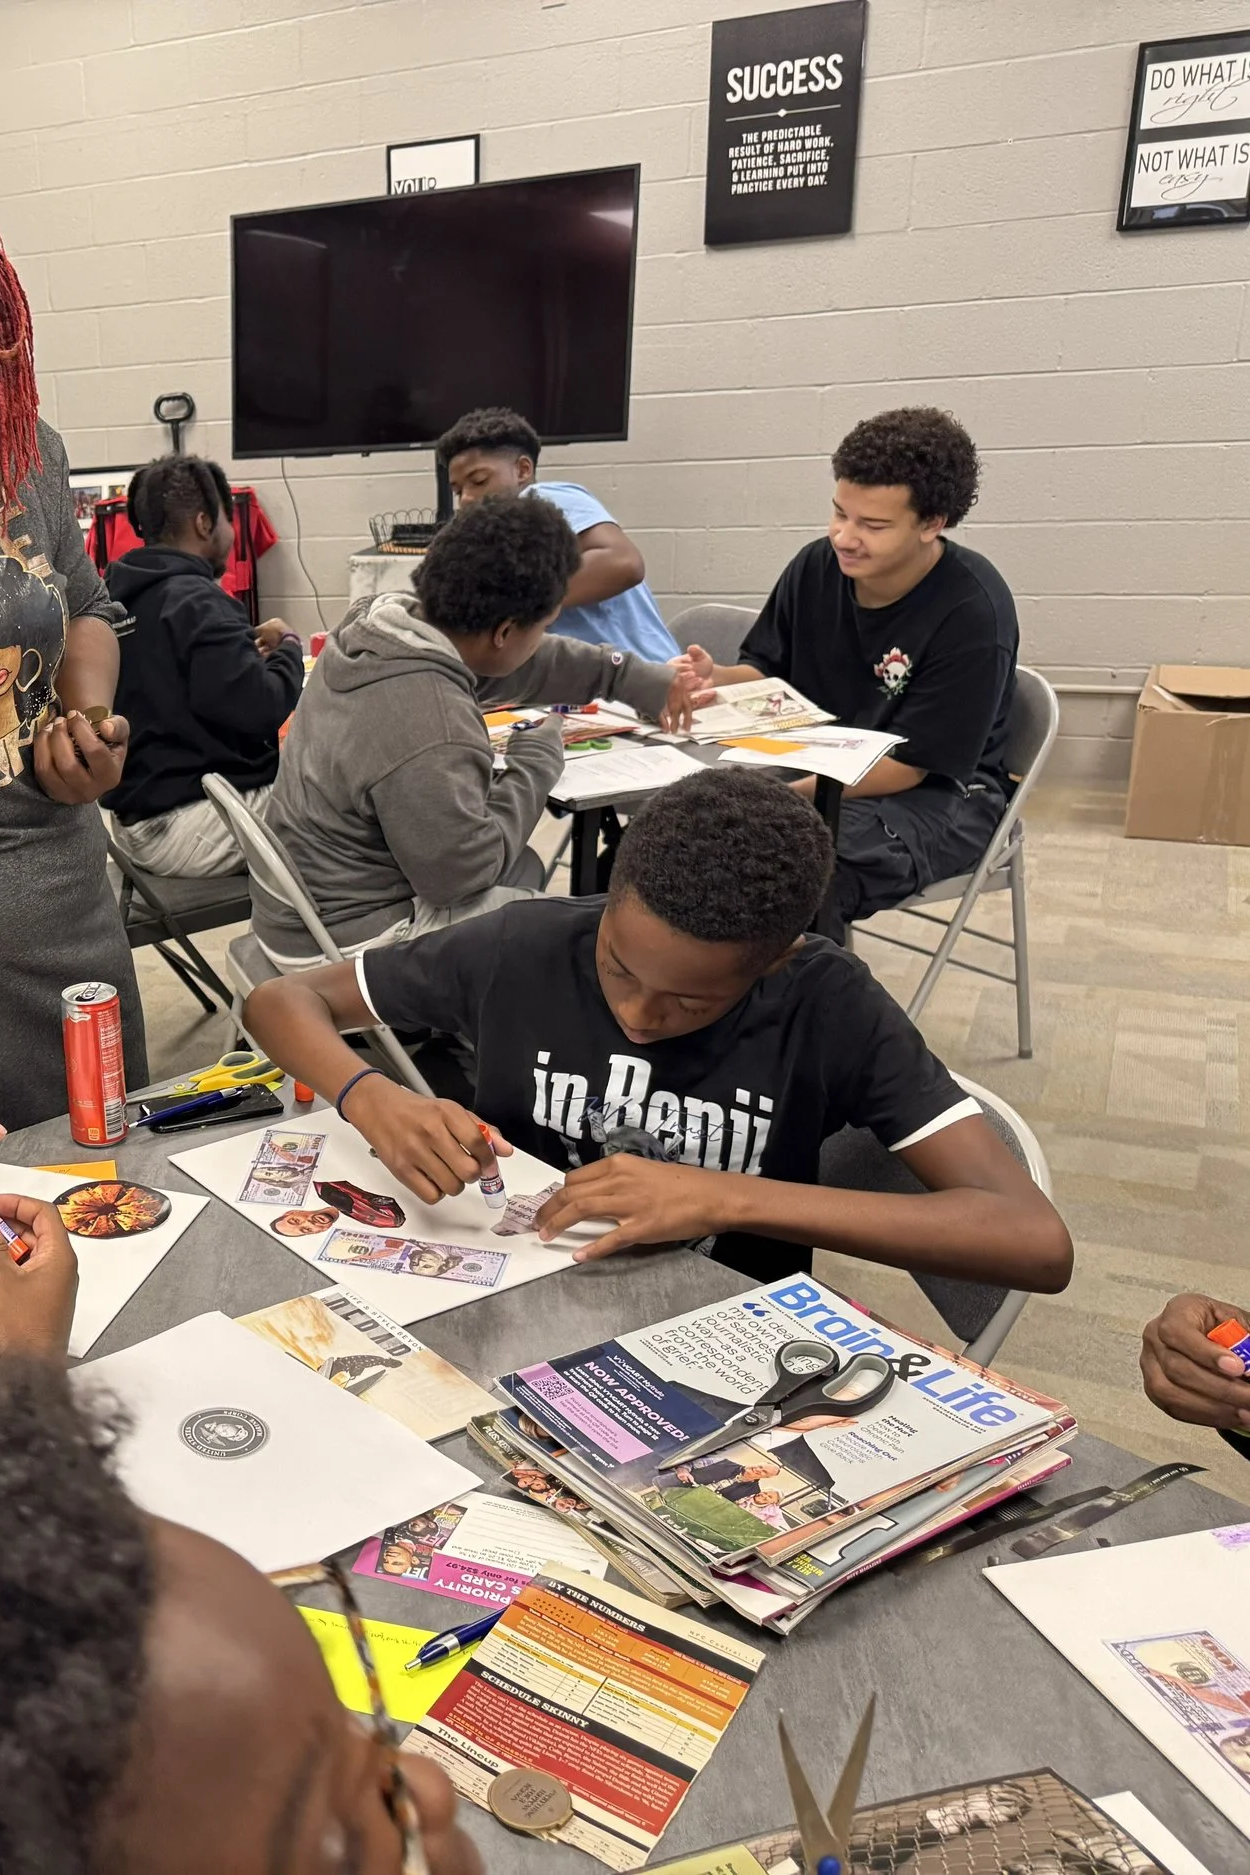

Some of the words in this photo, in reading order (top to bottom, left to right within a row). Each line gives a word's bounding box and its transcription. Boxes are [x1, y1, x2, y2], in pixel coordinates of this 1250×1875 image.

[726, 53, 843, 103] SUCCESS
[1150, 67, 1175, 91] DO
[1182, 60, 1237, 87] WHAT
[742, 132, 759, 144] THE
[761, 124, 822, 142] PREDICTABLE
[729, 144, 761, 158] RESULT
[763, 142, 775, 154] OF
[777, 139, 802, 152] HARD
[1138, 150, 1174, 174] NOT
[1178, 145, 1229, 170] WHAT
[1233, 142, 1250, 165] IS
[732, 170, 739, 182] &
[740, 166, 785, 181] LEARNING
[787, 164, 805, 176] PUT
[807, 161, 829, 174] INTO
[731, 181, 774, 195] PRACTICE
[776, 177, 805, 191] EVERY
[1159, 172, 1223, 201] easy
[534, 1051, 588, 1138] in
[345, 1292, 361, 1304] LIFE
[371, 1311, 396, 1330] STYLE
[716, 1311, 733, 1322] of
[727, 1306, 750, 1322] my
[747, 1320, 777, 1341] own
[650, 1334, 670, 1347] of
[699, 1314, 769, 1364] journalistic
[664, 1329, 696, 1352] from
[693, 1351, 716, 1369] the
[714, 1368, 755, 1395] world
[677, 1325, 769, 1392] correspondent
[767, 1280, 894, 1353] Brain
[887, 1351, 930, 1382] &
[911, 1364, 1017, 1434] Life
[568, 1368, 593, 1388] treatment
[591, 1387, 604, 1398] from
[620, 1411, 633, 1422] Turn
[637, 1424, 652, 1436] page
[569, 1375, 581, 1385] scan
[595, 1398, 610, 1409] code
[613, 1412, 627, 1424] learn
[574, 1366, 591, 1379] Learn
[590, 1379, 603, 1390] about
[647, 1425, 660, 1435] new
[583, 1361, 618, 1386] NOW
[613, 1386, 690, 1442] APPROVED!
[867, 1424, 885, 1435] Deal
[884, 1434, 901, 1444] with
[874, 1422, 890, 1431] How
[881, 1418, 894, 1426] the
[894, 1425, 913, 1437] Hurt
[887, 1415, 918, 1434] Healing
[197, 1445, 225, 1456] UNITED
[826, 1440, 866, 1463] Conditions
[833, 1437, 873, 1461] Neurologic
[840, 1434, 866, 1450] People
[866, 1449, 883, 1460] with
[847, 1432, 883, 1453] Reaching
[881, 1451, 897, 1461] Out
[860, 1427, 887, 1443] Chronic
[887, 1443, 905, 1454] Pain
[819, 1443, 836, 1453] Give
[836, 1452, 854, 1464] Back
[418, 1534, 446, 1546] JET
[401, 1565, 428, 1580] JET
[444, 1560, 479, 1573] $24.97
[480, 1567, 502, 1579] only
[503, 1574, 519, 1583] for
[791, 1562, 811, 1576] HELP
[793, 1556, 824, 1576] MISSING
[432, 1577, 511, 1603] PRIORITY
[460, 1572, 504, 1591] CARD
[548, 1580, 565, 1591] BY
[564, 1588, 588, 1603] THE
[587, 1599, 647, 1632] NUMBERS
[480, 1670, 542, 1706] SCHEDULE
[540, 1701, 590, 1729] SKINNY
[436, 1727, 462, 1744] The
[460, 1741, 499, 1768] Lineup
